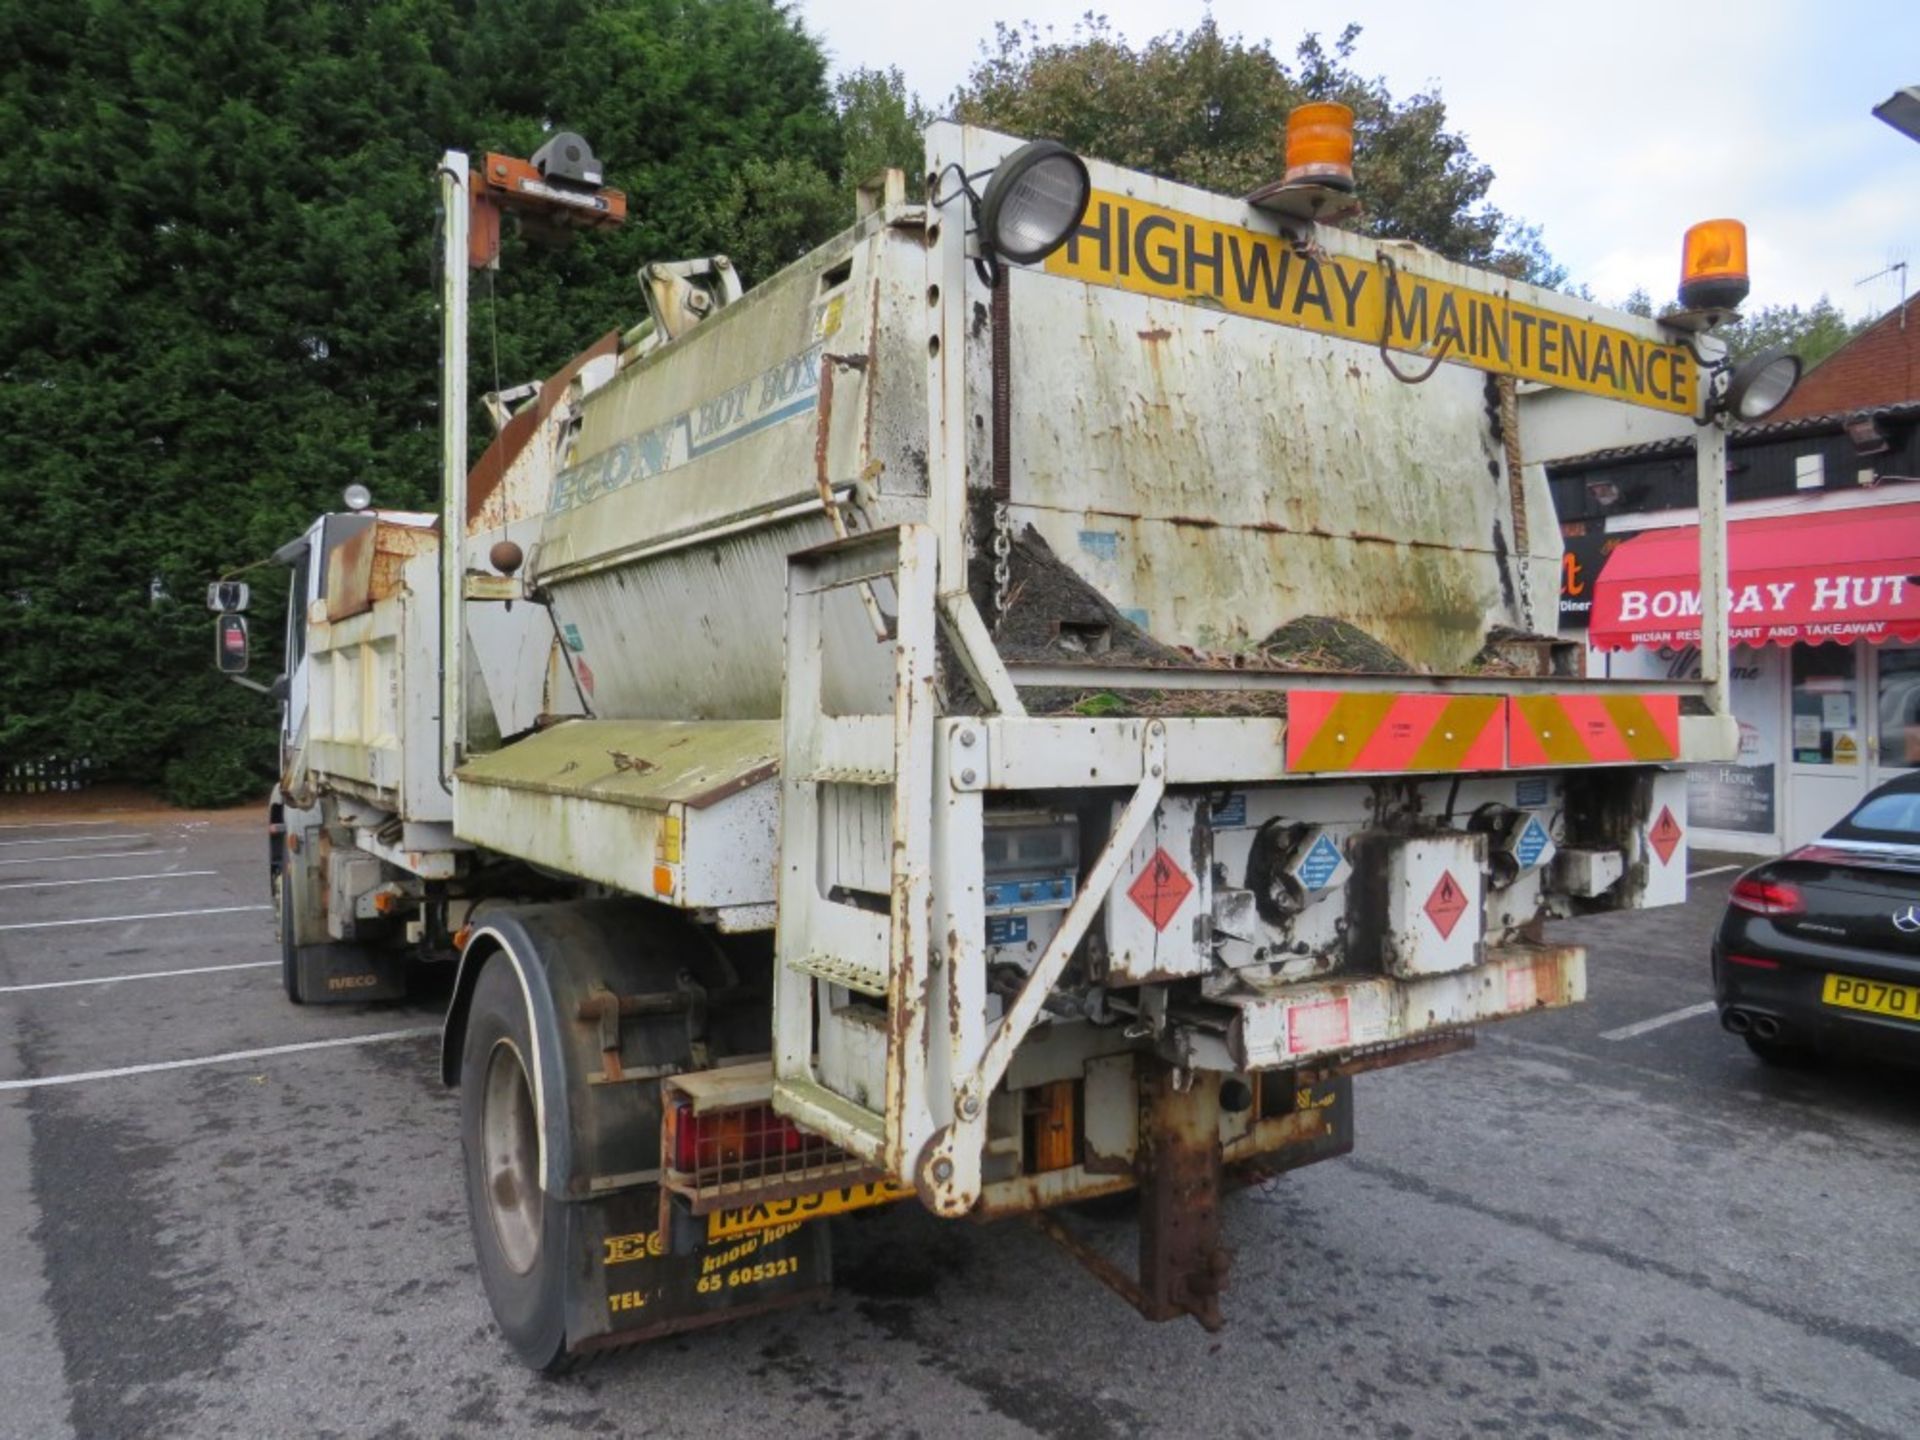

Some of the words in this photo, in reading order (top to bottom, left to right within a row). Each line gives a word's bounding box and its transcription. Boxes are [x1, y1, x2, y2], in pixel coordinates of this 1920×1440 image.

[1067, 201, 1368, 327] HIGHWAY
[1385, 278, 1687, 404] MAINTENANCE
[1618, 583, 1795, 622] BOMAY
[1811, 575, 1905, 611] HUT
[1632, 631, 1671, 642] INDIAN
[1676, 628, 1761, 641] RESRANT
[1769, 625, 1798, 637] AND
[1805, 621, 1886, 636] TAKEAWAY
[1660, 643, 1759, 680] Weme
[702, 1239, 757, 1274] know
[728, 1256, 799, 1287] 605321
